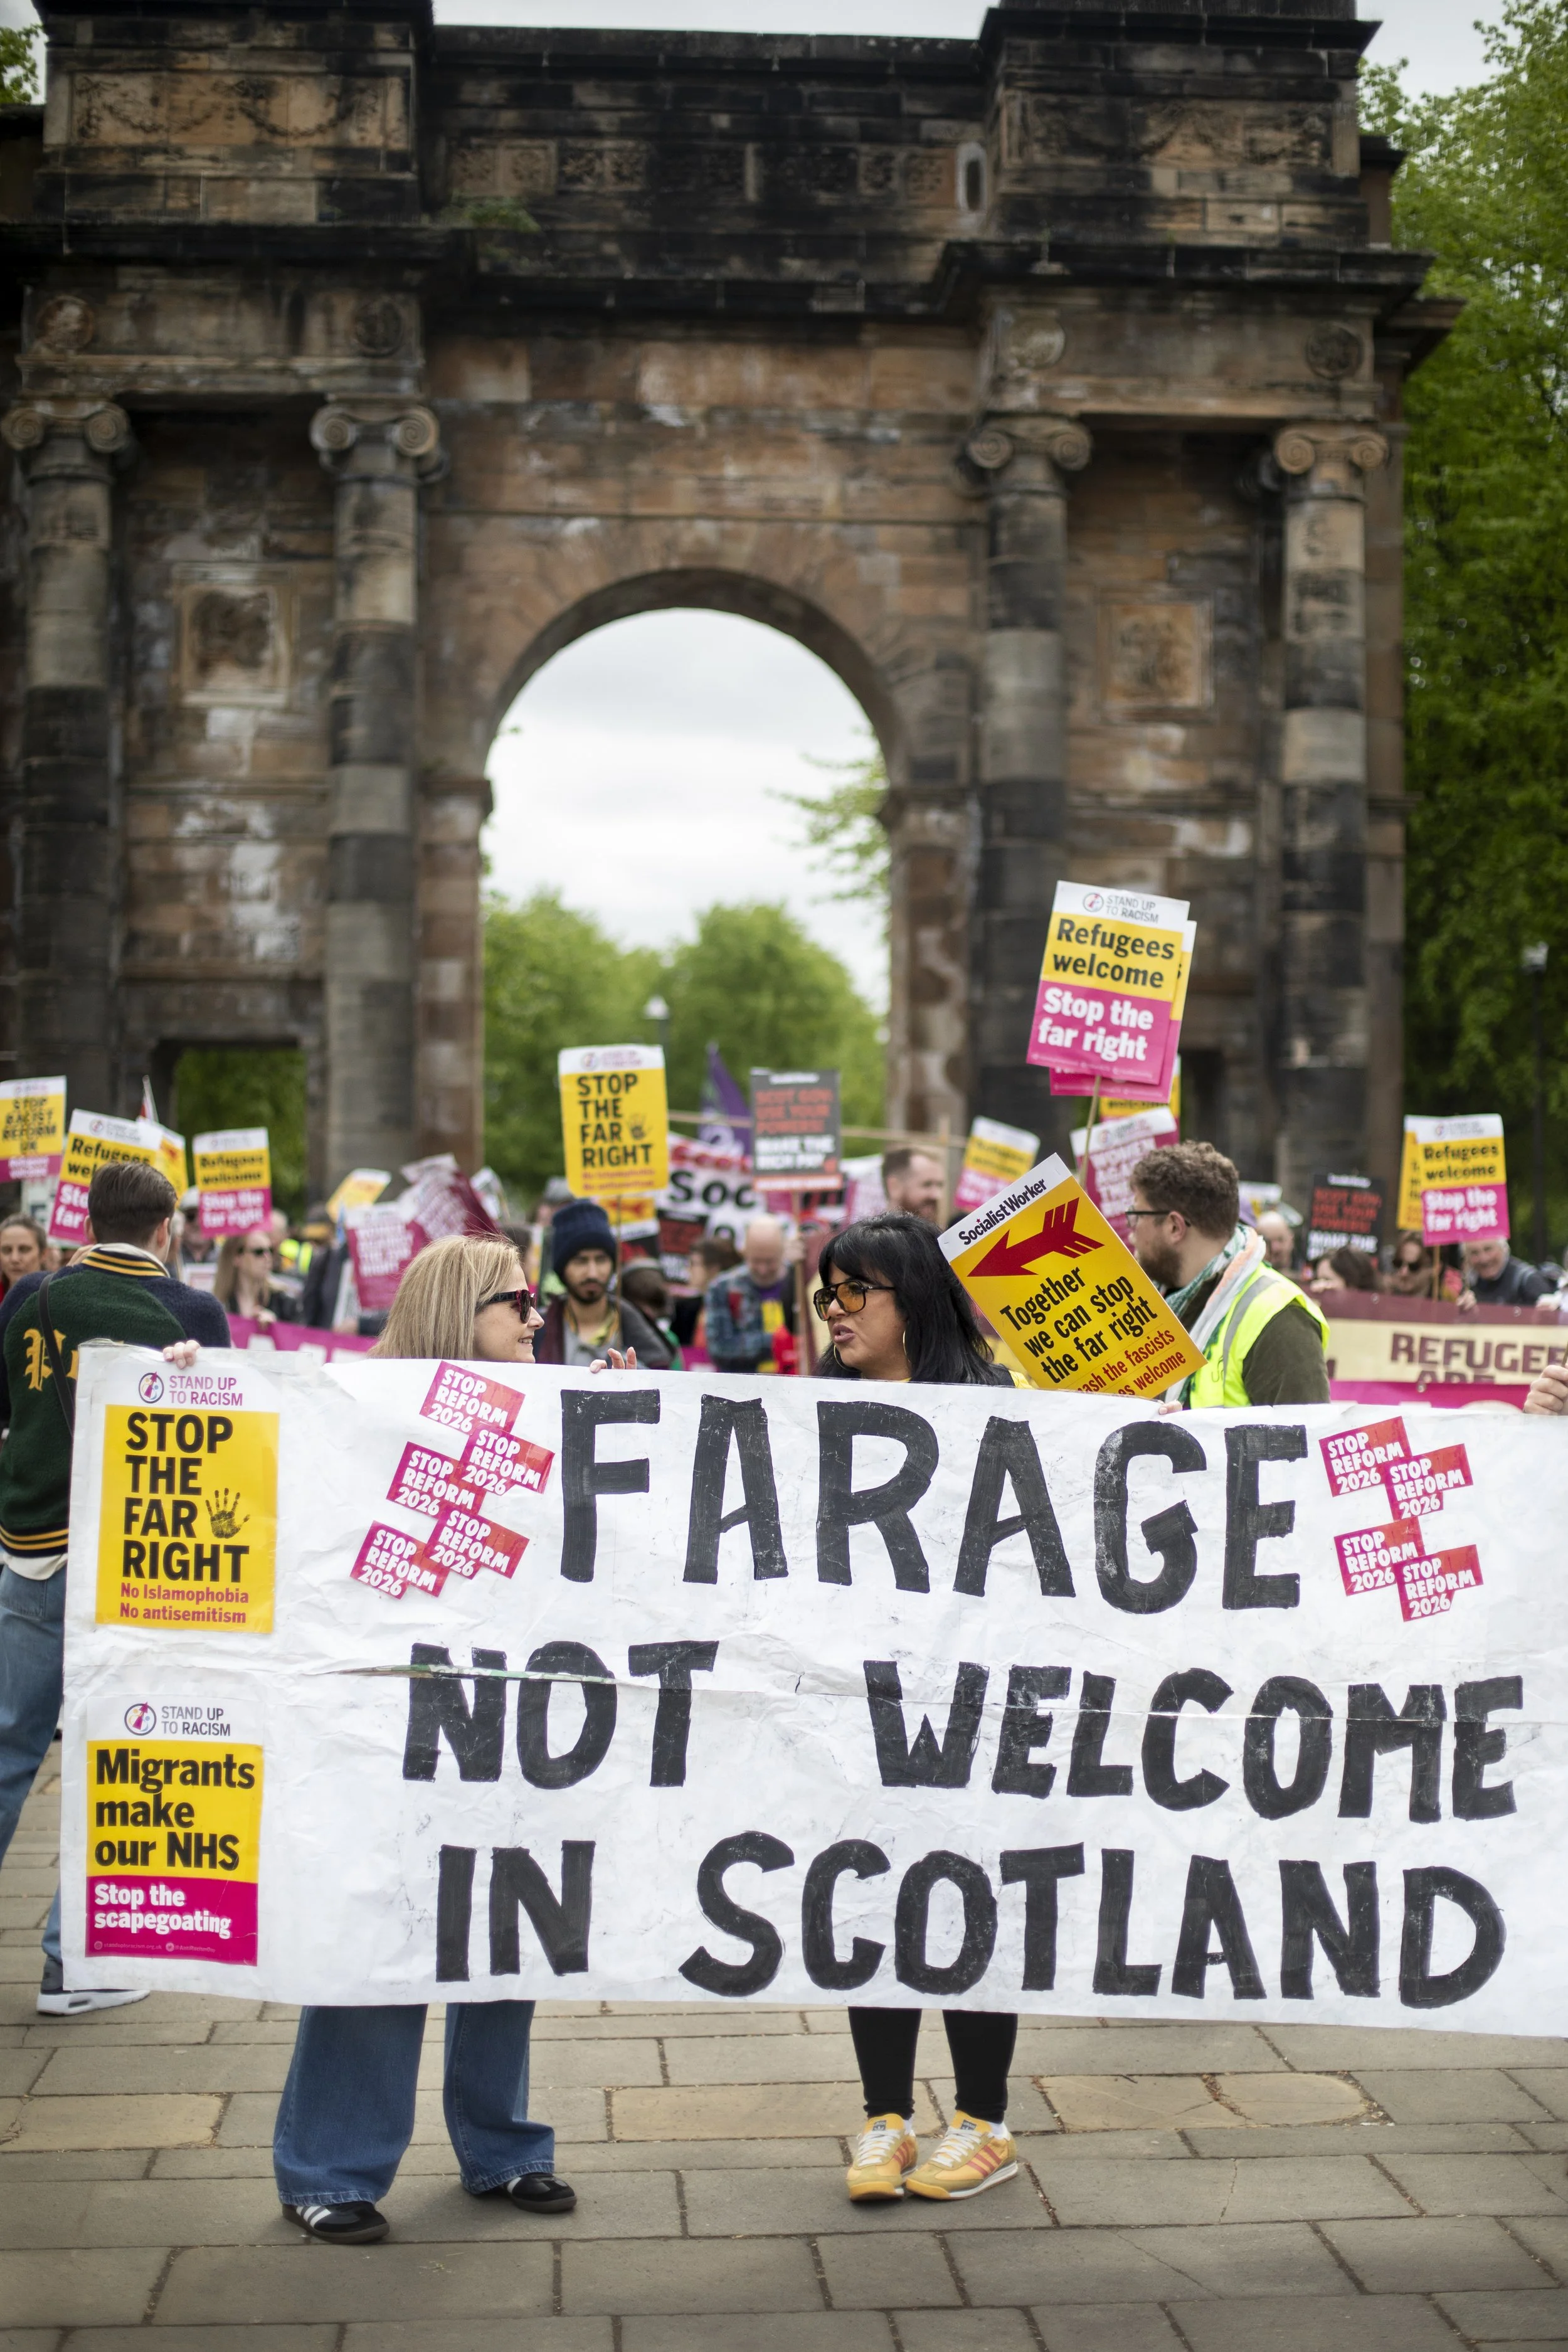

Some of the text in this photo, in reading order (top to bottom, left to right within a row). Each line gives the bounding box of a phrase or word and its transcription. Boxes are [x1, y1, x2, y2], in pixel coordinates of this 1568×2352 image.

[1106, 906, 1158, 923] TO RACISM
[1107, 895, 1156, 911] STAND UP
[1057, 918, 1175, 960] Refugees
[1053, 954, 1164, 988] welcome
[1043, 987, 1154, 1030] Stop the
[1038, 1017, 1148, 1062] far right
[577, 1073, 637, 1096] STOP
[579, 1098, 622, 1119] THE
[581, 1123, 622, 1143] FAR
[201, 1155, 263, 1171] Refugees
[583, 1144, 652, 1168] RIGHT
[1424, 1145, 1499, 1160] Refugees
[203, 1173, 262, 1185] welcome
[1426, 1165, 1496, 1180] welcome
[1424, 1186, 1497, 1213] Stop the
[55, 1205, 83, 1229] far
[1426, 1210, 1453, 1232] far
[1454, 1206, 1498, 1232] right
[1000, 1266, 1087, 1332] Together
[1024, 1275, 1134, 1358] we can stop
[1041, 1296, 1158, 1384] the far right
[1102, 1360, 1128, 1381] the
[1124, 1330, 1175, 1367] fascists
[169, 1375, 237, 1391] STAND UP
[442, 1369, 487, 1397] STOP
[1133, 1351, 1186, 1391] welcome
[169, 1391, 243, 1406] TO RACISM
[435, 1385, 509, 1428] REFORM
[125, 1411, 233, 1454] STOP
[427, 1403, 474, 1433] 2026
[476, 1429, 521, 1458] STOP
[1328, 1432, 1369, 1458] STOP
[1331, 1441, 1405, 1476] REFORM
[125, 1454, 202, 1496] THE
[408, 1450, 454, 1478] STOP
[469, 1446, 542, 1489] REFORM
[1389, 1458, 1432, 1484] STOP
[402, 1467, 475, 1510] REFORM
[462, 1465, 507, 1495] 2026
[1337, 1468, 1381, 1495] 2026
[1394, 1469, 1465, 1502] REFORM
[395, 1486, 440, 1517] 2026
[559, 1388, 1308, 1614] FARAGE
[1399, 1493, 1441, 1520] 2026
[124, 1497, 198, 1539] FAR
[446, 1510, 491, 1540] STOP
[373, 1530, 418, 1557] STOP
[438, 1527, 511, 1573] REFORM
[1342, 1531, 1385, 1556] STOP
[1345, 1542, 1418, 1574] REFORM
[122, 1539, 250, 1583] RIGHT
[365, 1545, 437, 1591] REFORM
[429, 1545, 476, 1578] 2026
[1402, 1558, 1442, 1583] STOP
[120, 1582, 249, 1606] No Islamophobia
[358, 1565, 402, 1597] 2026
[1351, 1567, 1396, 1594] 2026
[1405, 1570, 1476, 1600] REFORM
[120, 1602, 246, 1624] No antisemitism
[1409, 1594, 1452, 1618] 2026
[161, 1706, 224, 1721] STAND UP
[162, 1721, 231, 1737] TO RACISM
[402, 1640, 1523, 1825] NOT WELCOME
[96, 1748, 255, 1794] Migrants
[95, 1792, 194, 1828] make
[95, 1831, 240, 1872] our NHS
[94, 1882, 186, 1910] Stop the
[94, 1910, 231, 1939] scapegoating
[436, 1830, 1506, 2010] IN SCOTLAND
